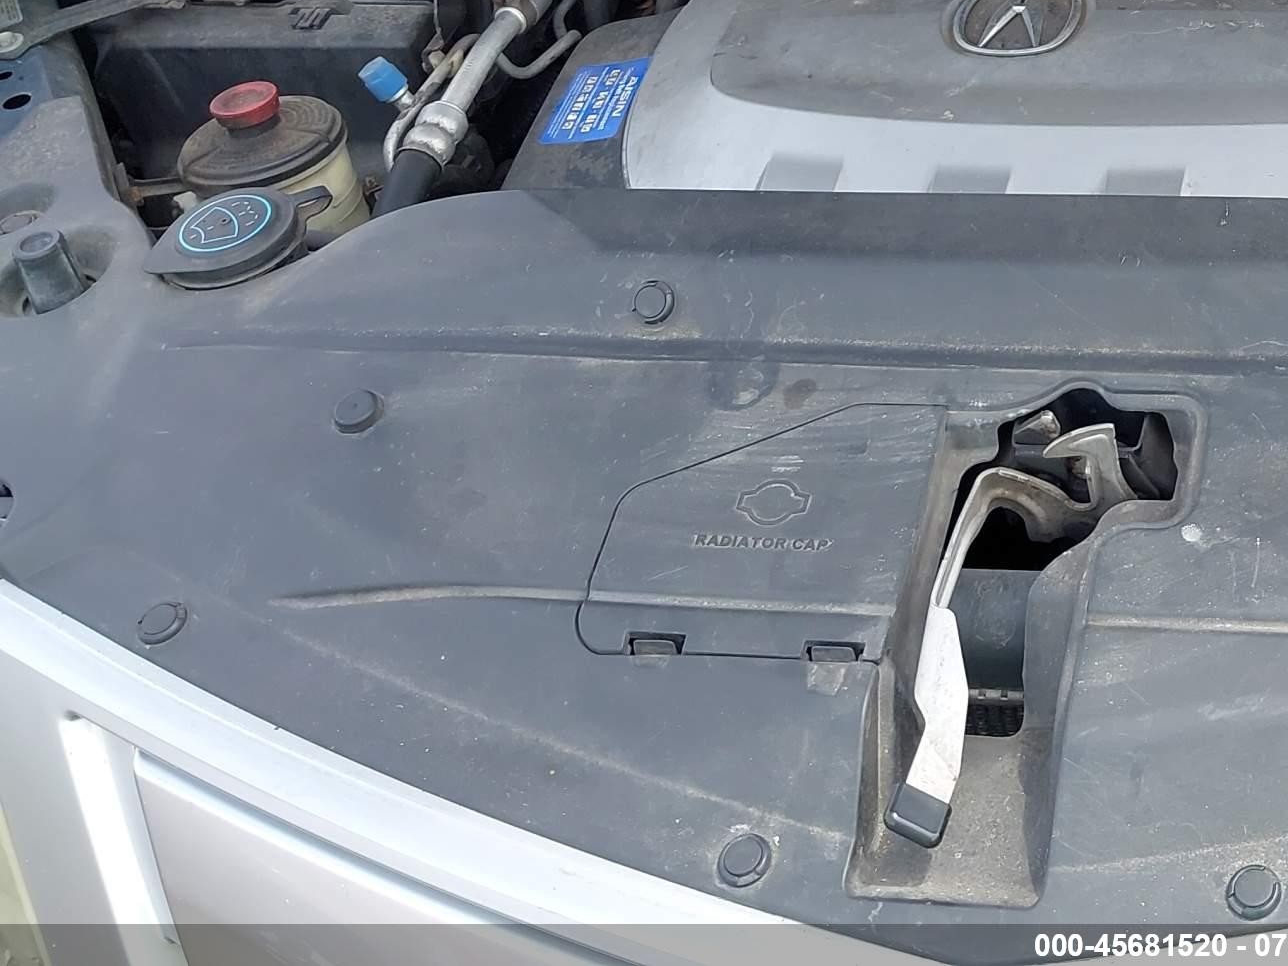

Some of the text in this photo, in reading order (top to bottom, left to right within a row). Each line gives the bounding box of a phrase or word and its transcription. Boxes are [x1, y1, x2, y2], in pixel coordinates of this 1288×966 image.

[612, 76, 639, 117] AISIN
[694, 534, 834, 552] RADIATOR CAP
